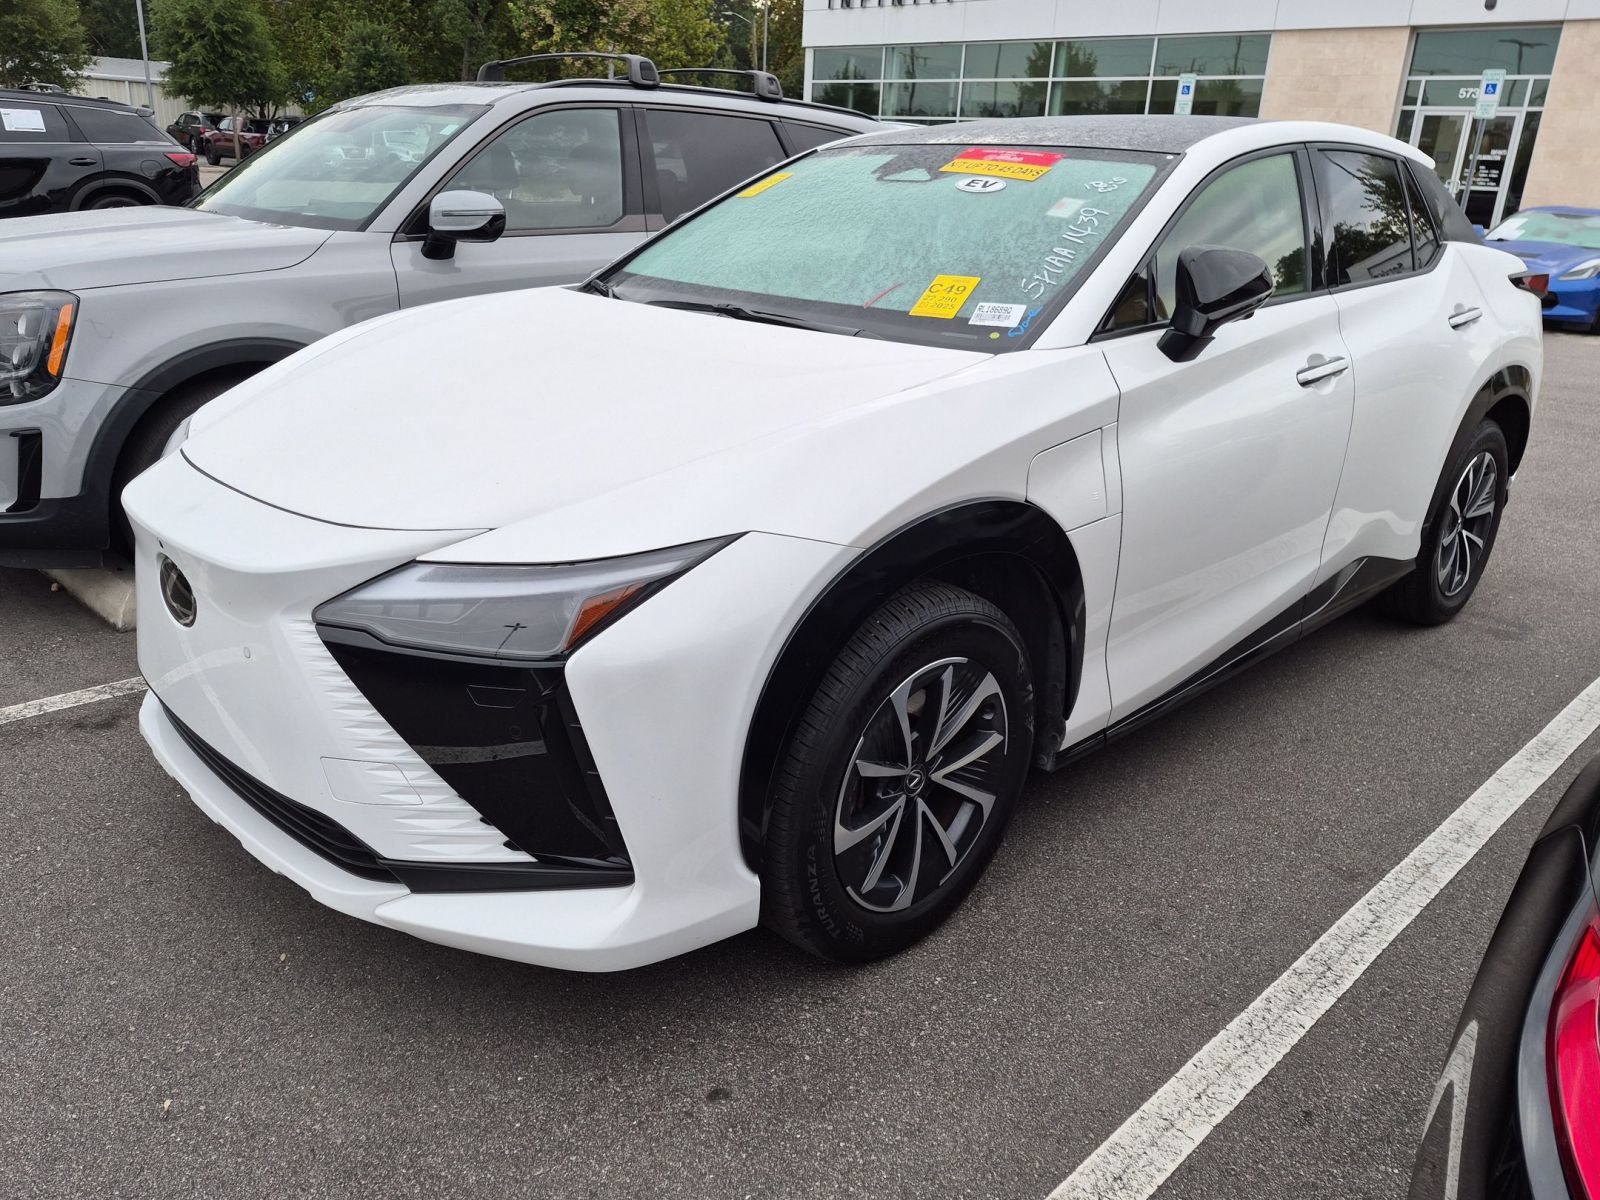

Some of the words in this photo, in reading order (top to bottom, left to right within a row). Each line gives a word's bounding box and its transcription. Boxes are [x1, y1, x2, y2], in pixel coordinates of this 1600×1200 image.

[982, 163, 998, 171] TO
[1012, 167, 1044, 177] DAYS
[965, 179, 998, 188] EV
[1062, 207, 1109, 244] 1439
[928, 283, 967, 295] C49
[807, 844, 841, 938] TURANZA
